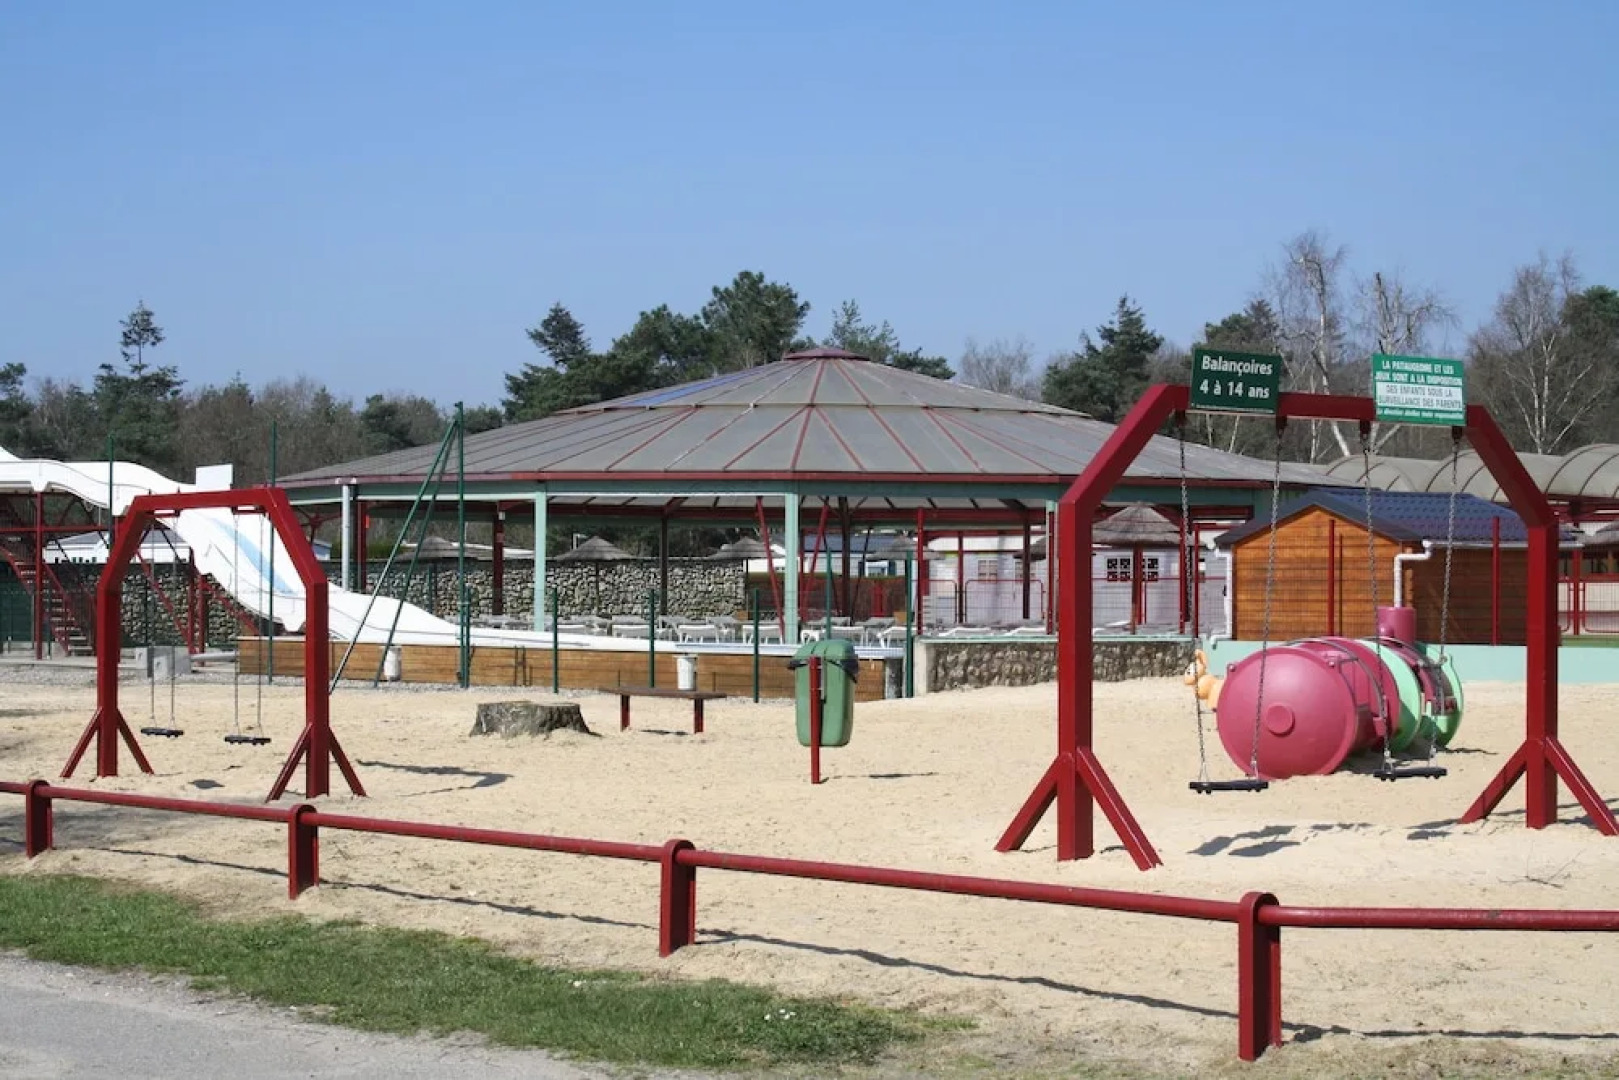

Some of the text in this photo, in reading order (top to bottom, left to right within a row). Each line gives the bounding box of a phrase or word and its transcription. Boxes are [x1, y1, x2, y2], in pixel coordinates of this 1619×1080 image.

[1202, 355, 1273, 376] Balançoires
[1200, 379, 1270, 398] 4 à 14 ans
[1386, 384, 1453, 397] DES ENFANTS SOUS LA
[1379, 394, 1461, 409] SURVEILLANCE DES PARENTS
